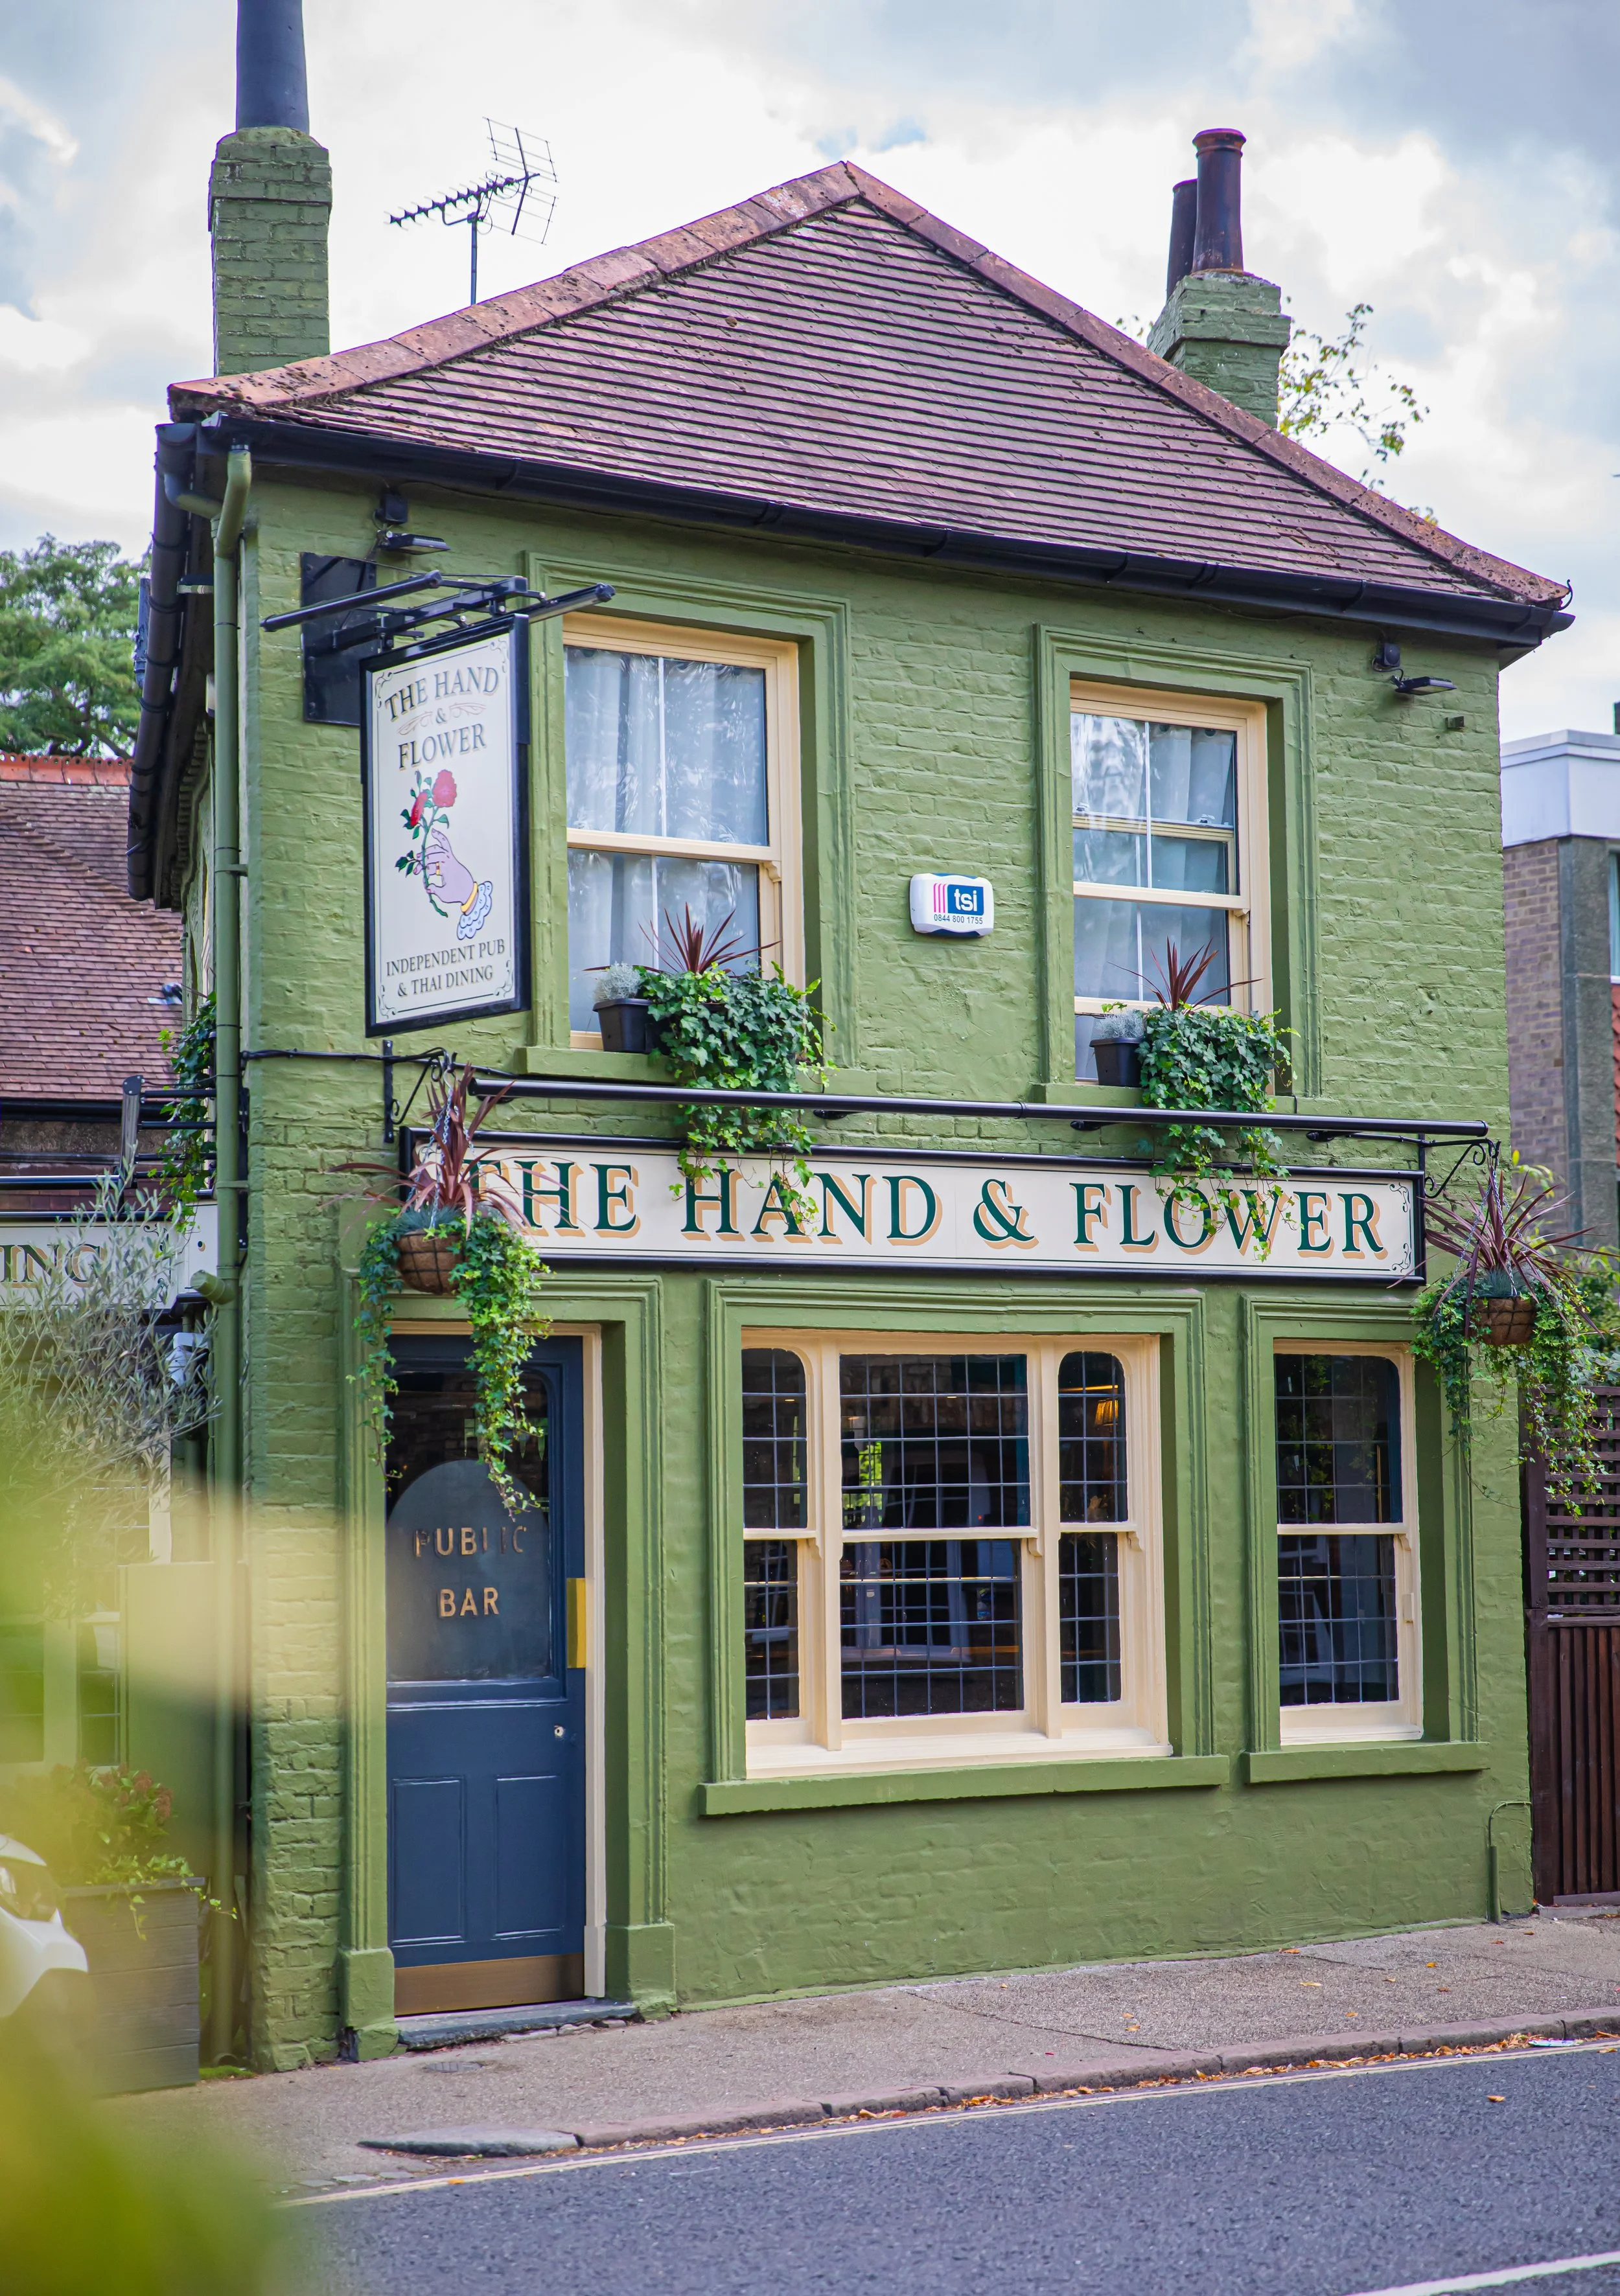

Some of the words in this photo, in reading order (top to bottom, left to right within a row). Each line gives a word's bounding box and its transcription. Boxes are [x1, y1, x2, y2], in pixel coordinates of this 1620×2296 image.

[384, 678, 428, 722] THE
[434, 667, 499, 700] HAND
[435, 707, 447, 725] &
[398, 723, 487, 771] FLOWER
[954, 888, 978, 912] tsi
[934, 913, 950, 922] 0844
[952, 915, 965, 923] 800
[967, 916, 984, 925] 1755
[386, 944, 475, 976] INDEPENDENT
[478, 938, 505, 959] PUB
[397, 982, 408, 998] &
[411, 974, 442, 995] THAI
[446, 964, 494, 989] DINING
[677, 1166, 943, 1246] HAND
[973, 1179, 1039, 1250] &
[1069, 1182, 1388, 1260] FLOWER
[439, 1586, 500, 1618] BAR
